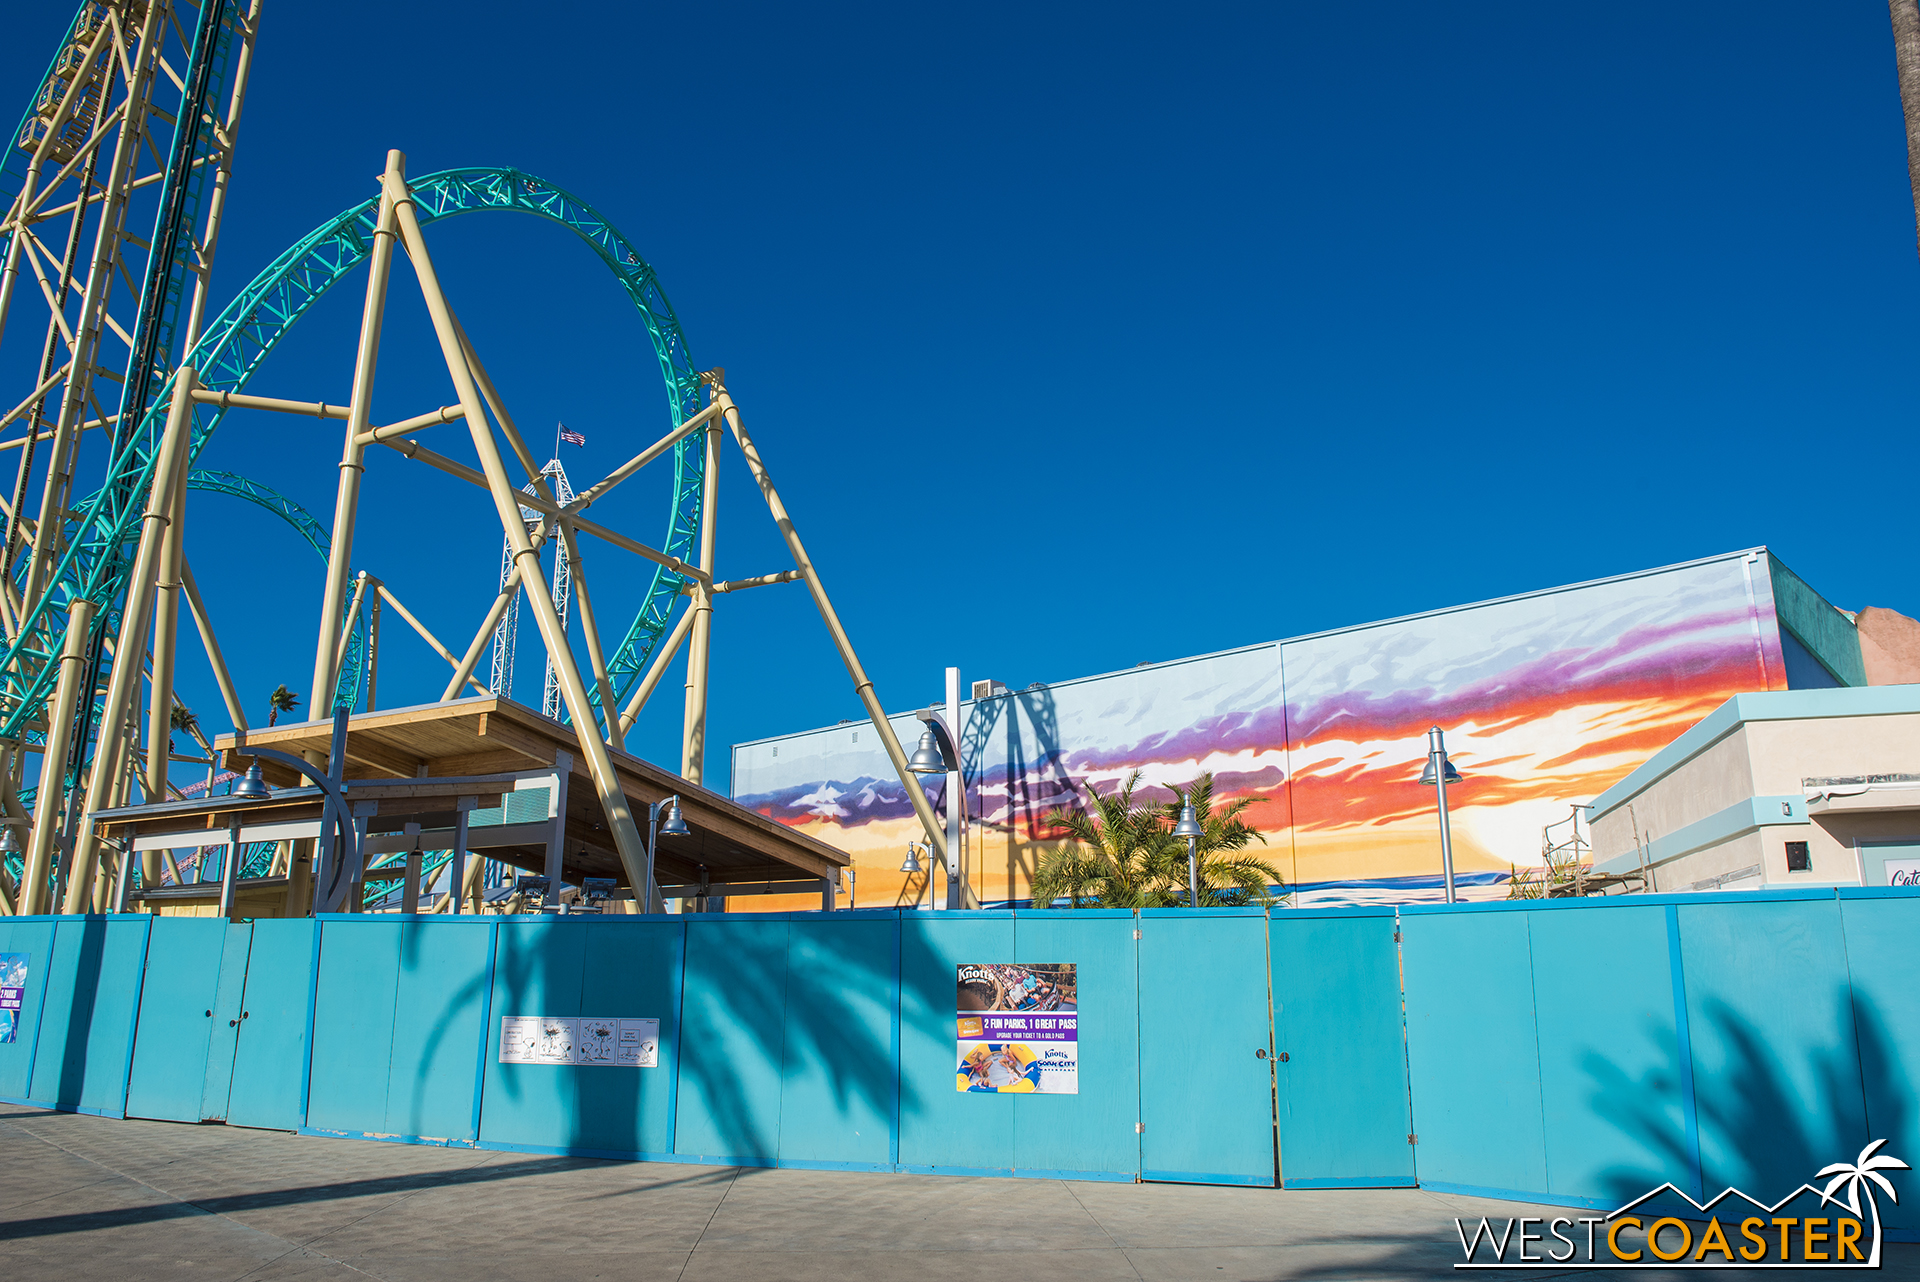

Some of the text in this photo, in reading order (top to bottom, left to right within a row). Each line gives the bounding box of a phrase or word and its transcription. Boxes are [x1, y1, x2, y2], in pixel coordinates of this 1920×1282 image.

[958, 966, 995, 982] Knott's
[984, 1018, 989, 1028] 2
[990, 1018, 1003, 1028] FUN
[1004, 1018, 1028, 1030] PARKS,
[1029, 1019, 1033, 1029] 1
[1059, 1019, 1077, 1029] PASS
[1044, 1048, 1068, 1059] Knott's
